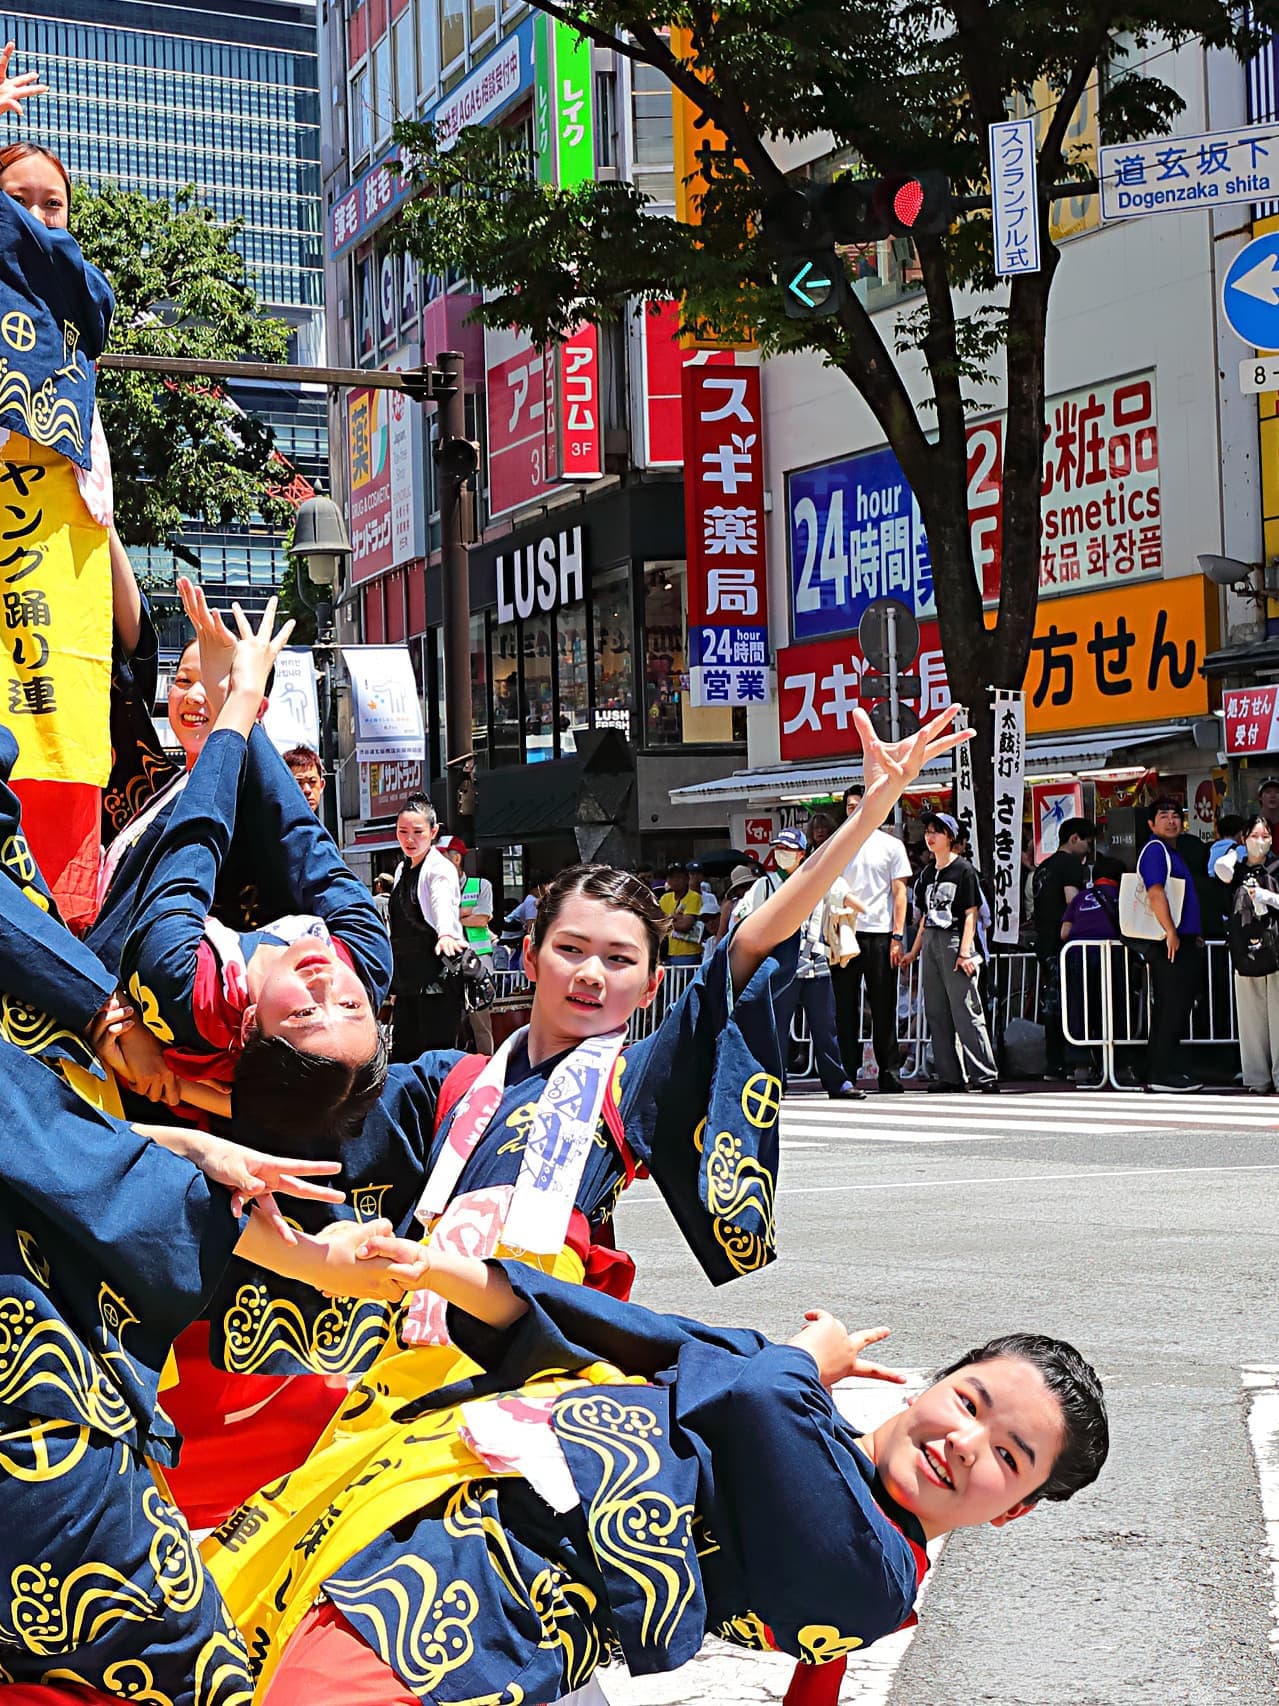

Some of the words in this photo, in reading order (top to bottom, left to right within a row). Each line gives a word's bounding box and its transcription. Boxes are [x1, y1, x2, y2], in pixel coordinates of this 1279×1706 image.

[539, 85, 549, 154] レイク
[562, 79, 585, 147] レイク
[1114, 137, 1270, 189] 道玄坂下
[1001, 127, 1030, 269] スクランブル式
[1118, 182, 1219, 209] Dogenzaka
[1225, 173, 1270, 195] shita
[565, 347, 595, 430] アコム
[571, 442, 593, 456] 3F
[700, 378, 759, 616] スギ薬局
[856, 484, 902, 521] hour
[496, 526, 584, 625] LUSH
[1086, 524, 1161, 578] 화장품
[736, 629, 761, 641] hour
[703, 669, 765, 701] 営業
[784, 650, 953, 735] スギ局
[1227, 695, 1271, 720] 処方せん
[595, 710, 630, 721] LUSH
[1234, 723, 1259, 747] 受付
